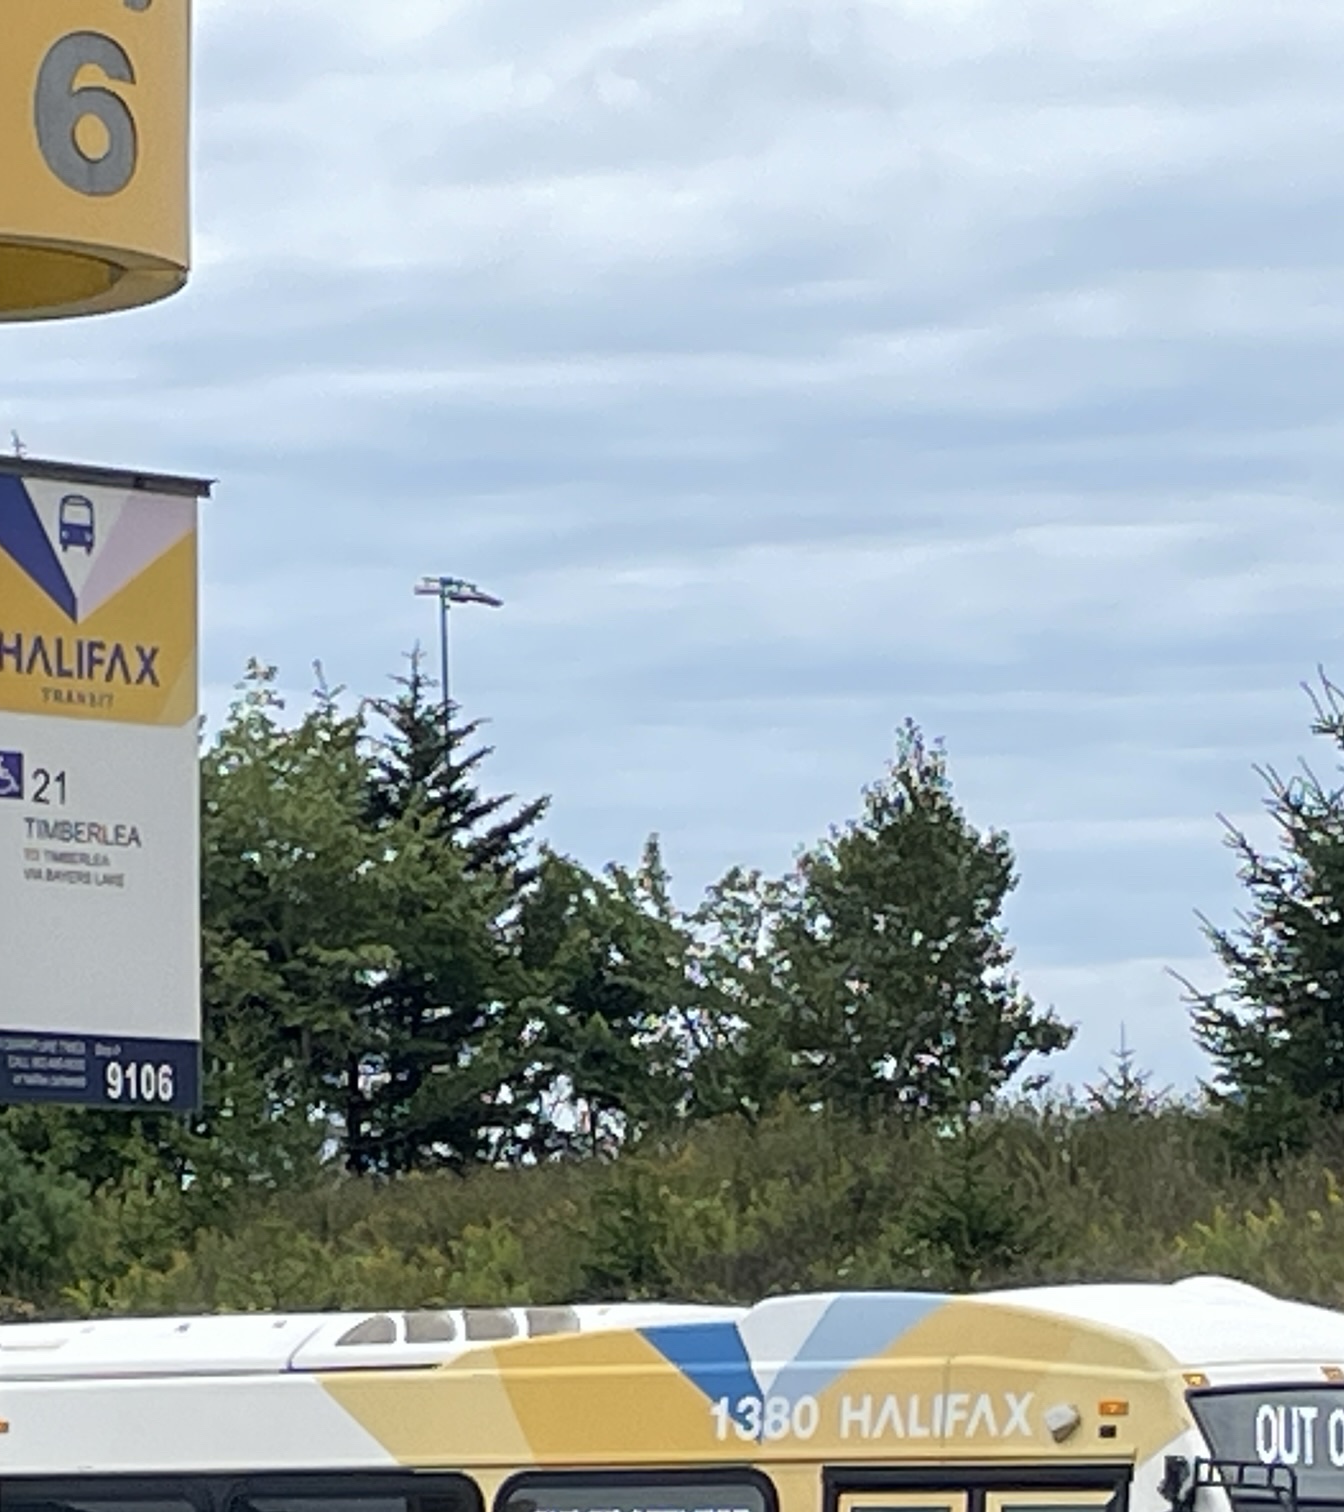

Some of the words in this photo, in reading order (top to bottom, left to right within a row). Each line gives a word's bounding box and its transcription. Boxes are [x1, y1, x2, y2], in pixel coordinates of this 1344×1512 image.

[35, 30, 137, 196] 6
[41, 687, 115, 708] TRANSIT
[32, 767, 66, 805] 21
[24, 817, 142, 848] TIMBERLEA
[107, 1061, 174, 1101] 9106
[710, 1395, 820, 1441] 1380
[838, 1392, 1035, 1439] HALIFAX
[1256, 1404, 1318, 1466] OUT
